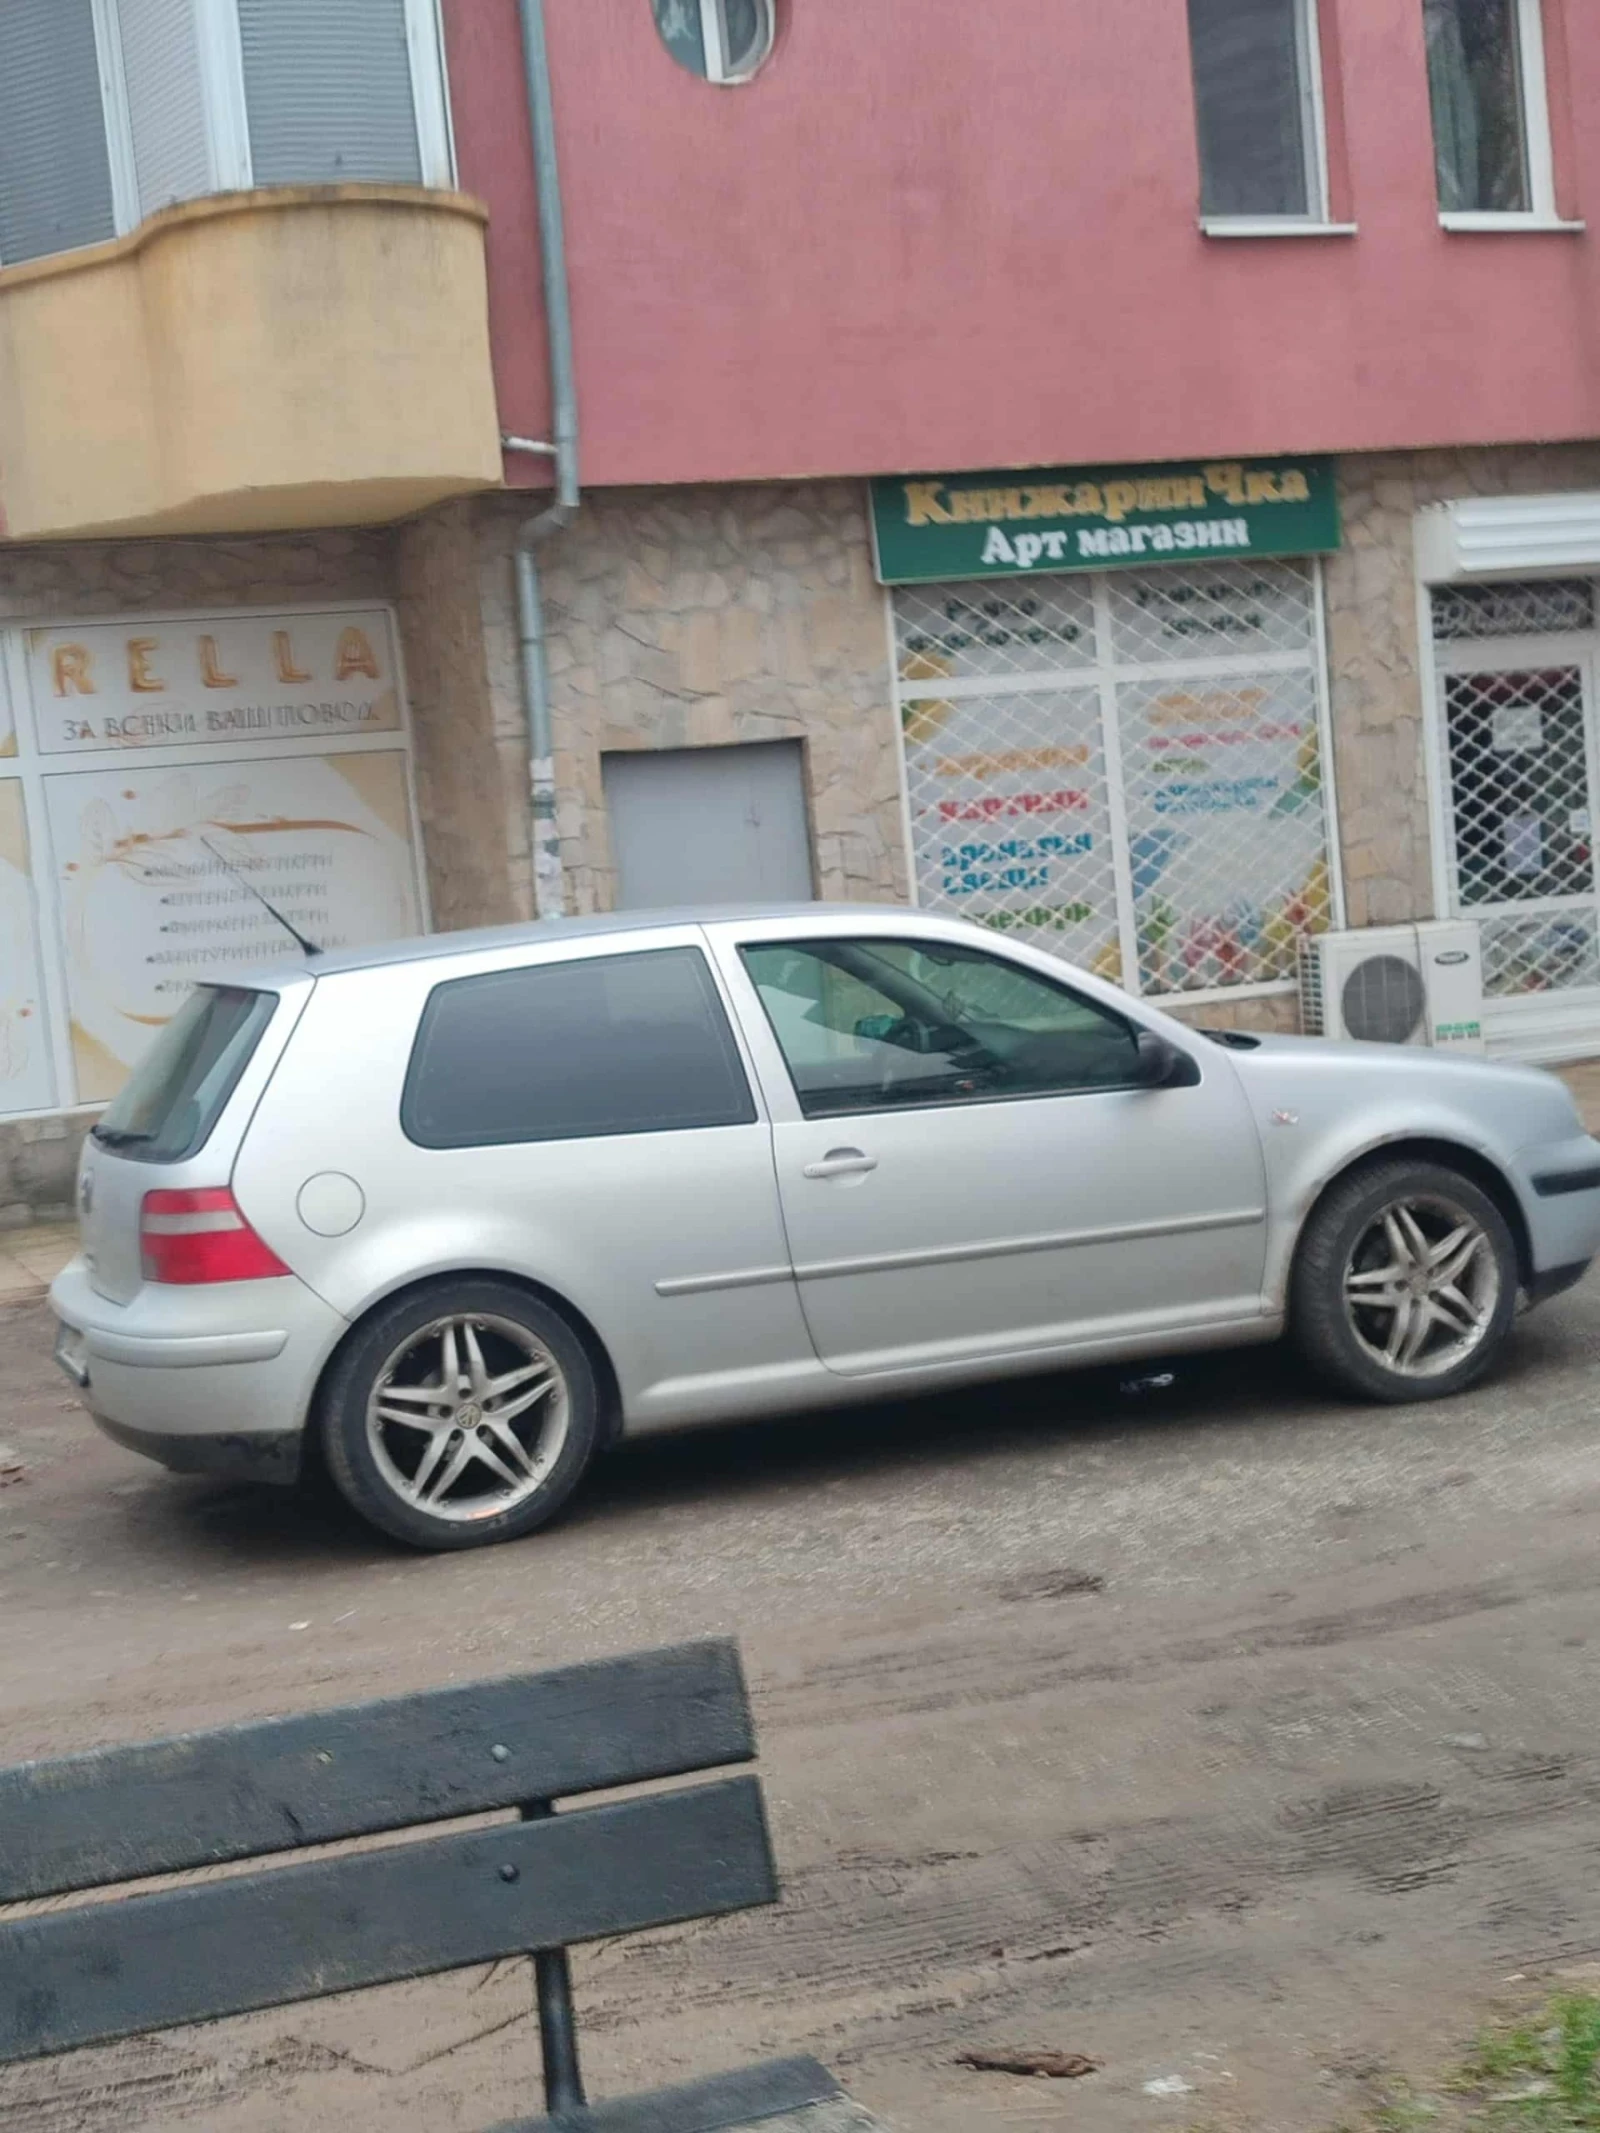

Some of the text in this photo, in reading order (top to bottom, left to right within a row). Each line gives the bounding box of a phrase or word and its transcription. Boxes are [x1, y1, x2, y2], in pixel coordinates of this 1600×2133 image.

[981, 518, 1251, 567] Арт магазин
[52, 626, 382, 697] RELLA
[63, 719, 95, 741] ЗА
[105, 711, 196, 738] ВСЕКИ
